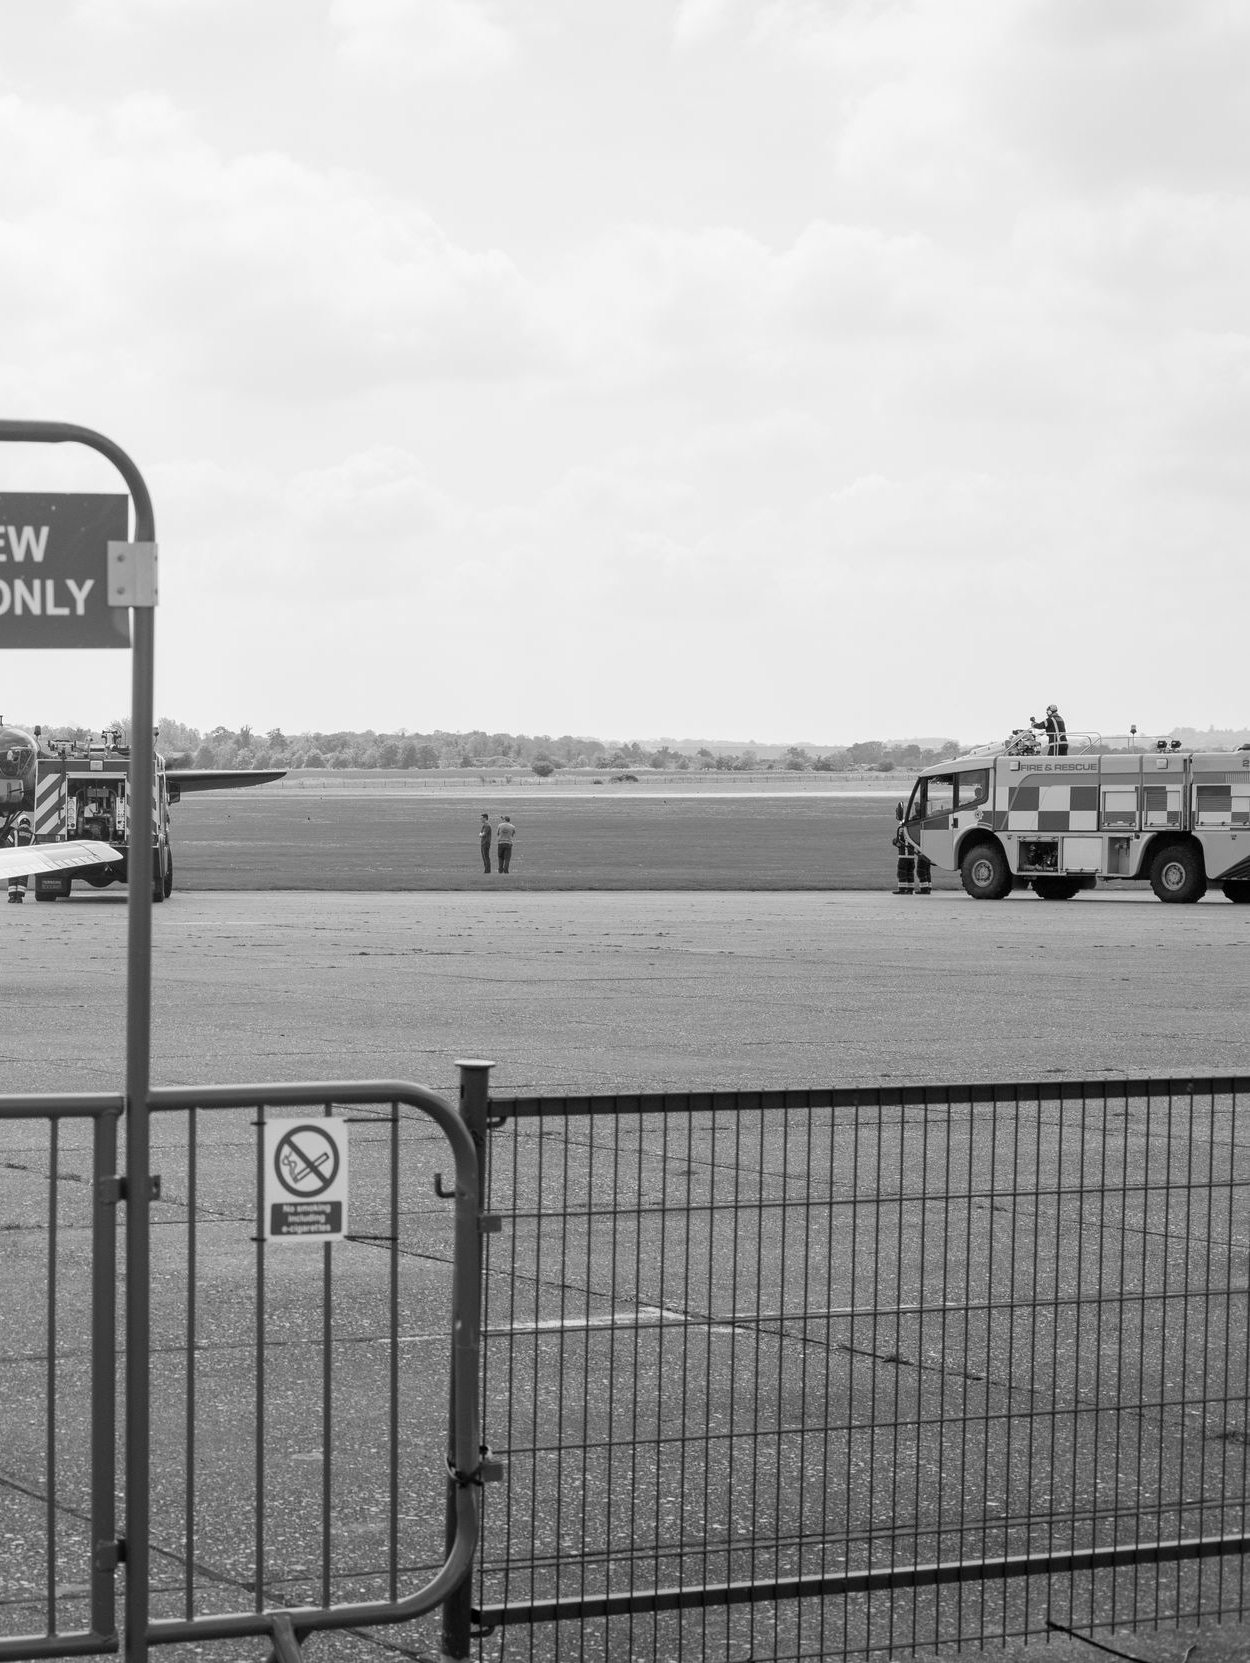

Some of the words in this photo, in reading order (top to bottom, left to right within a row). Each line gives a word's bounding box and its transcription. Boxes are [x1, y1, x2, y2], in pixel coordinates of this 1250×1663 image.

[1020, 764, 1043, 772] FIRE
[1044, 764, 1052, 772] &
[1054, 763, 1098, 771] RESCUE
[282, 1203, 295, 1213] No
[297, 1202, 331, 1214] smoking
[288, 1214, 326, 1224] including
[281, 1224, 331, 1235] e-cigarettes
